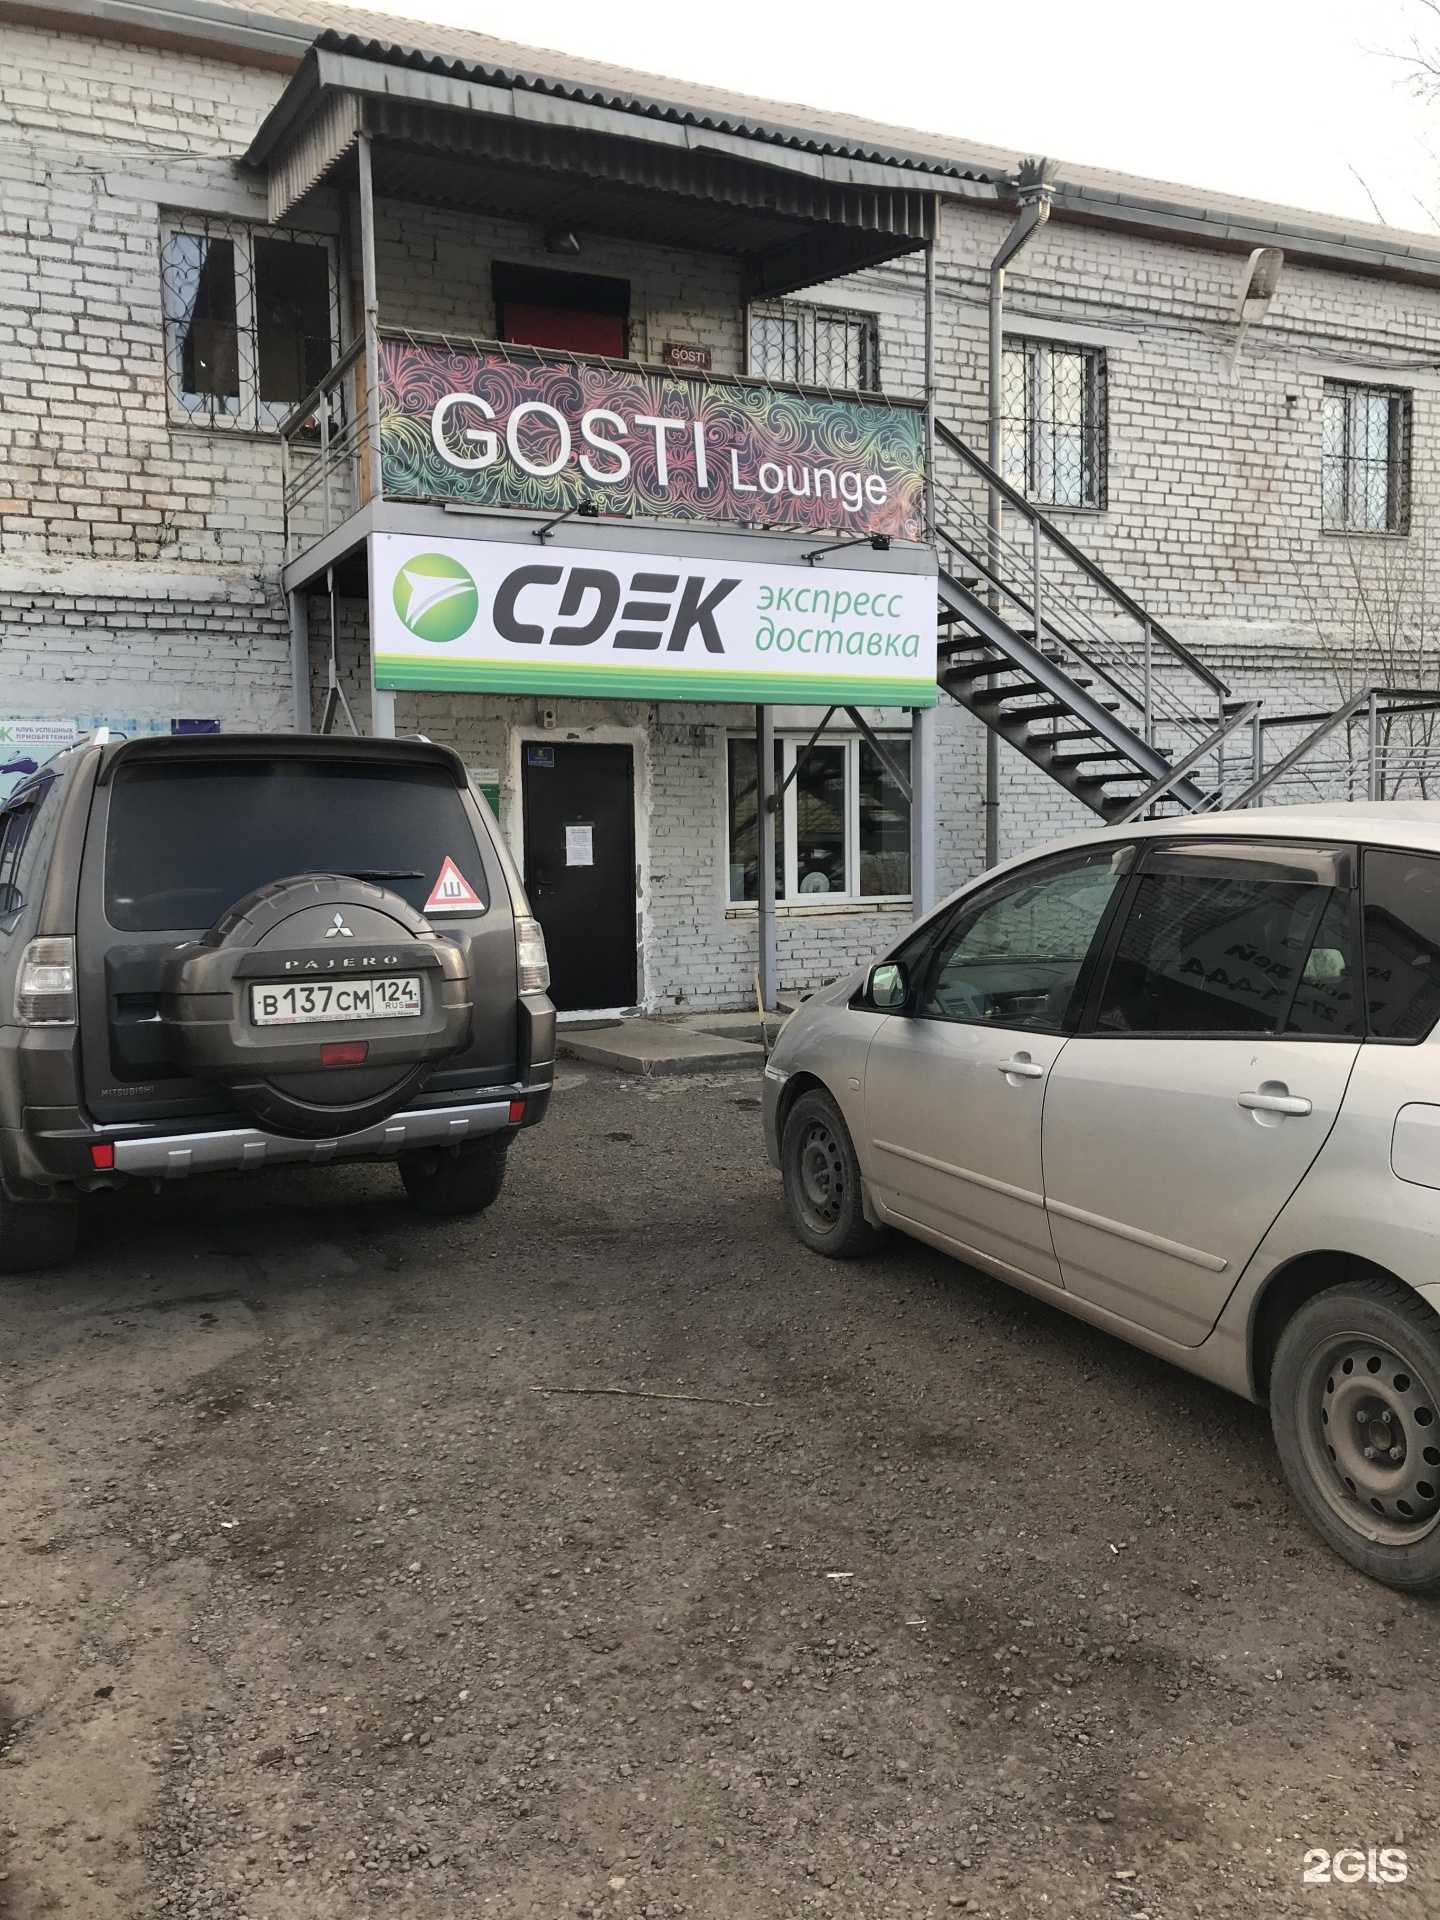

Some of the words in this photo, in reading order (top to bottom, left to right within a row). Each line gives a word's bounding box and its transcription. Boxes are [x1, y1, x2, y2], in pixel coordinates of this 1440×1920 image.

[671, 348, 705, 363] GOSTI
[431, 392, 708, 488] GOSTI
[731, 449, 888, 512] Lounge
[756, 584, 904, 622] экспресс
[755, 616, 921, 658] доставка
[285, 955, 398, 969] PAJERO
[375, 980, 414, 1002] 124
[385, 1001, 405, 1009] RUS
